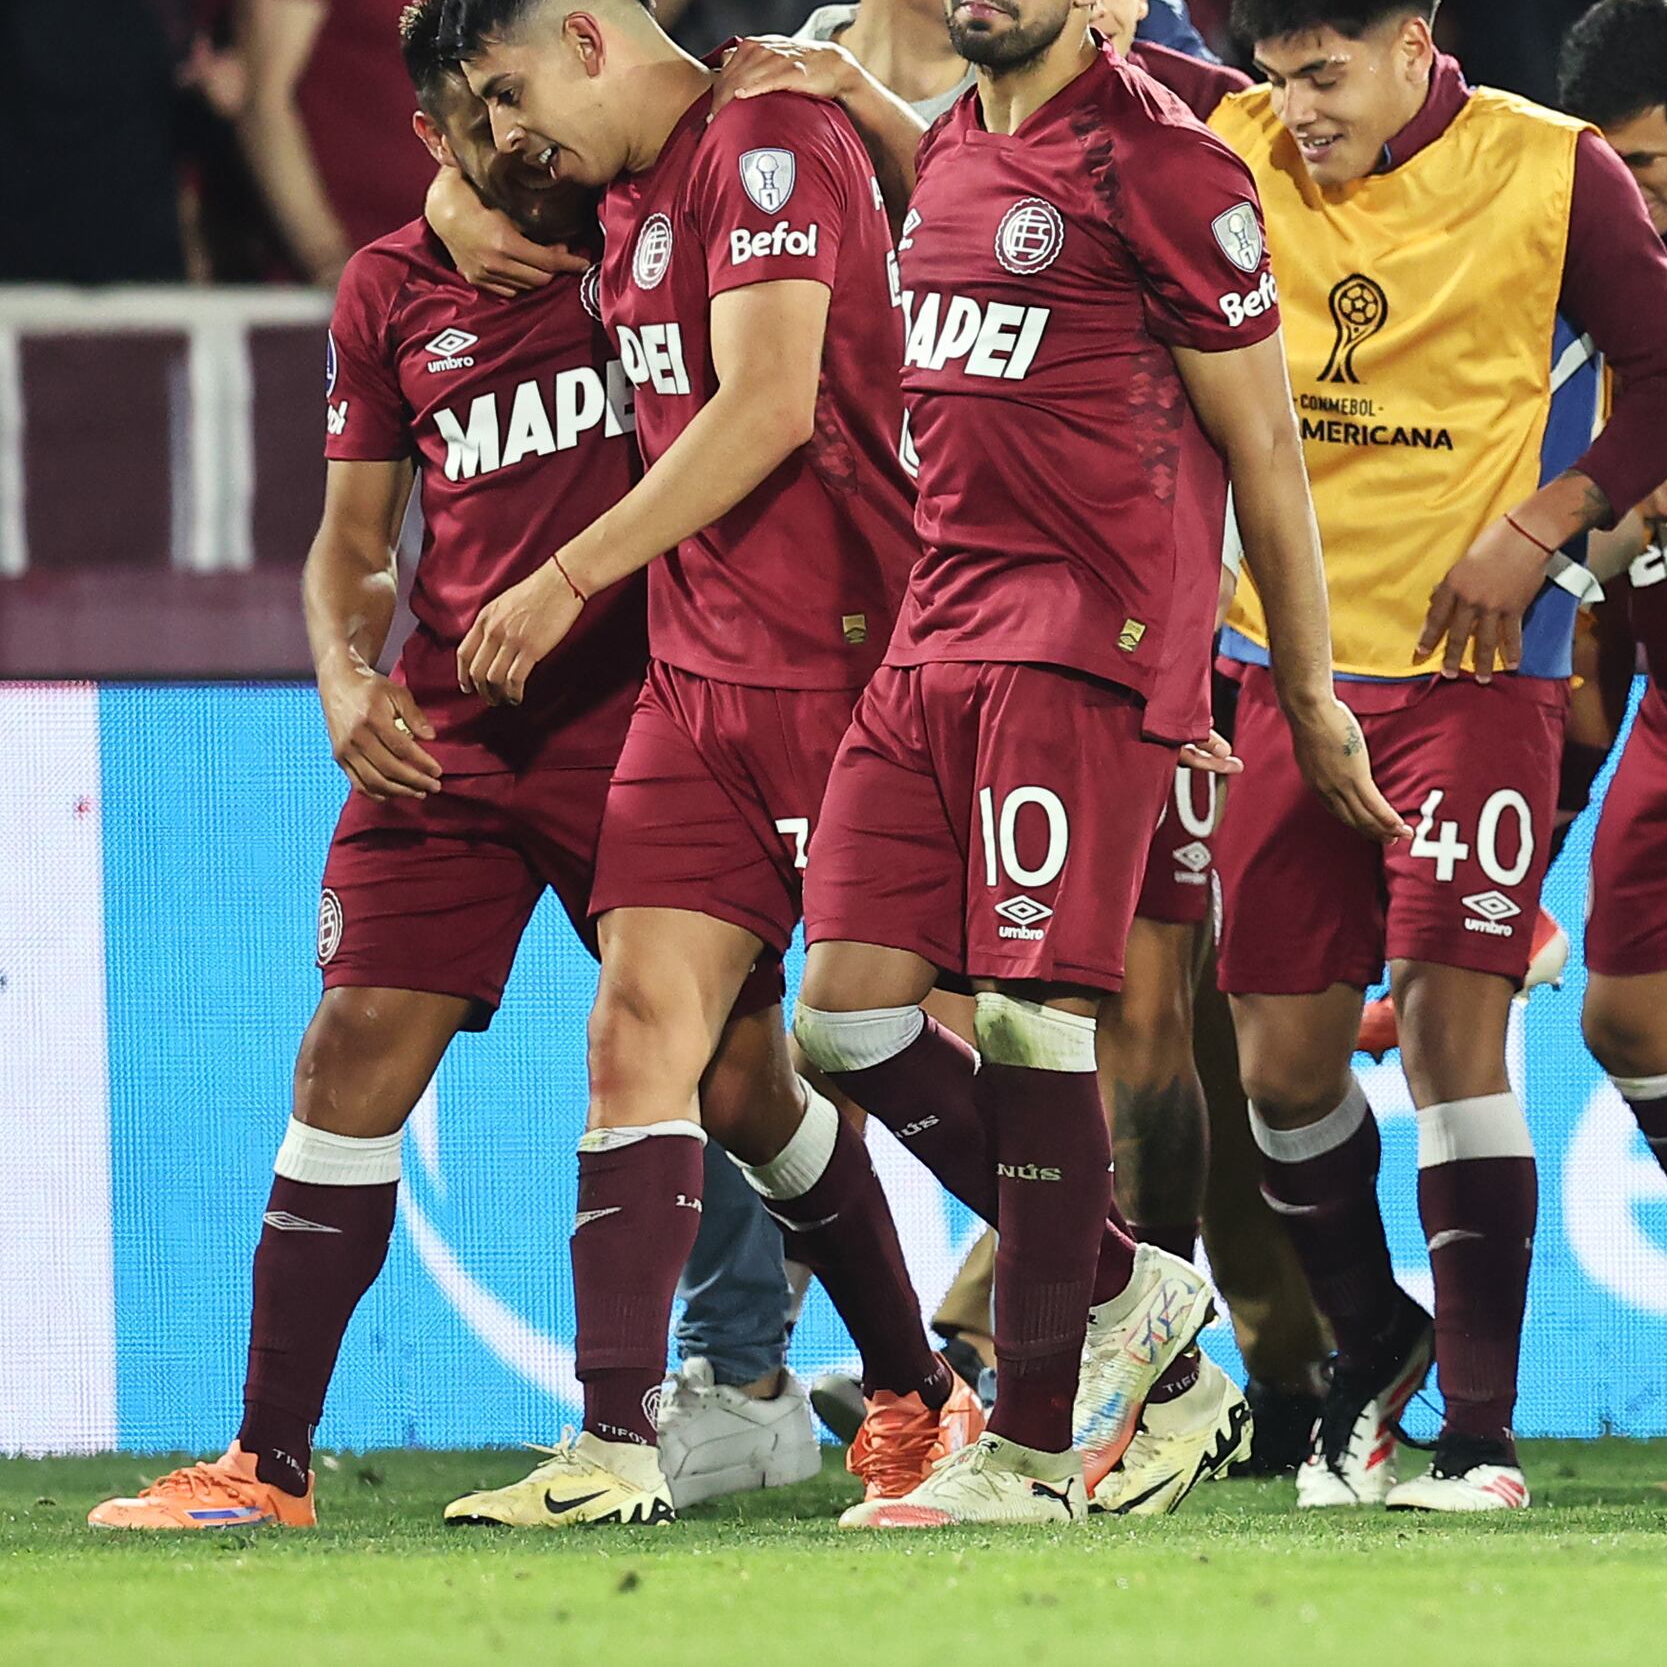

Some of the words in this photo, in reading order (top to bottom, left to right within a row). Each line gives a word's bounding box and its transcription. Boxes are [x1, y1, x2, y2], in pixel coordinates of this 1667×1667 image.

[730, 221, 818, 265] Befol
[1219, 273, 1278, 327] Befo
[427, 356, 474, 373] umbro
[616, 323, 690, 395] PEI
[433, 359, 636, 482] MAPE
[1300, 394, 1376, 416] CONMEBOL
[1301, 419, 1454, 451] MERICANA
[979, 785, 1069, 887] 10
[1410, 788, 1534, 887] 40
[999, 925, 1044, 941] umbro
[1464, 917, 1512, 937] umbro
[996, 1163, 1062, 1181] NÚS
